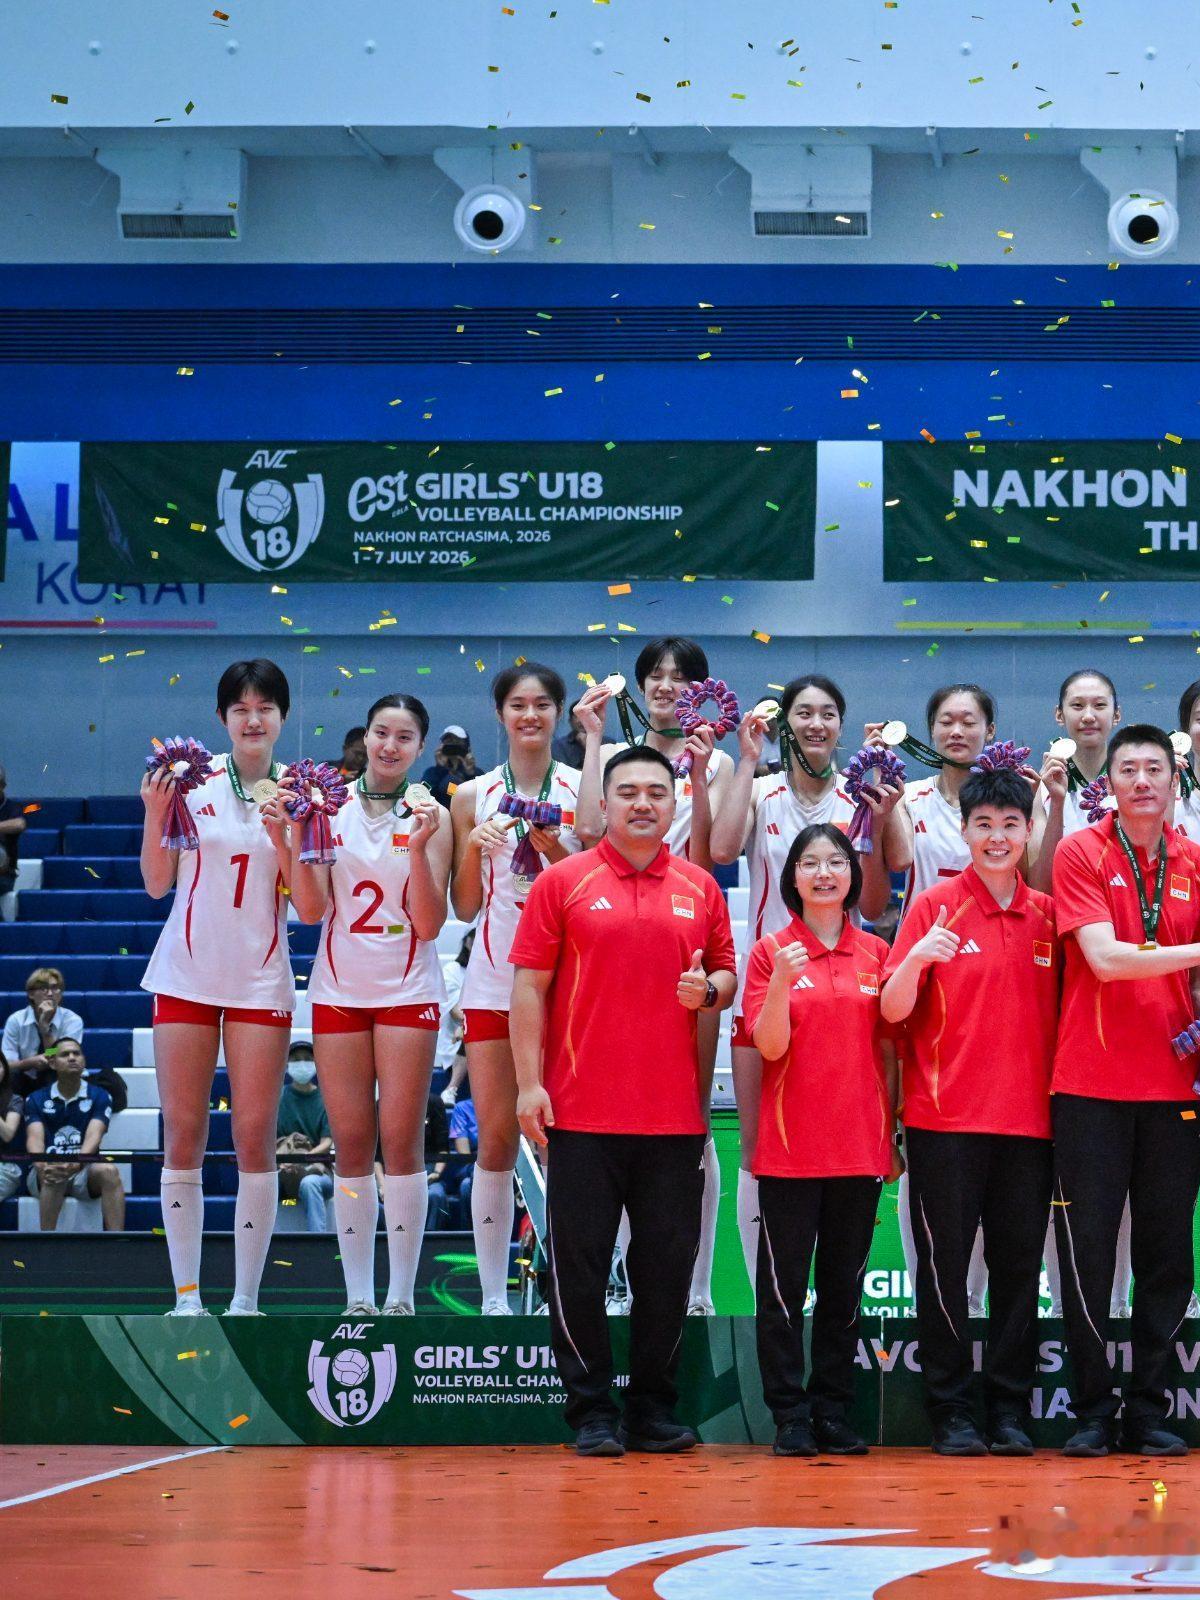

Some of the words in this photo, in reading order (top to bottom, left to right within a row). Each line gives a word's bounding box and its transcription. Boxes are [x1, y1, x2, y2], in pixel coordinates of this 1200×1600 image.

[244, 450, 298, 469] AVC
[348, 470, 408, 522] est
[415, 471, 528, 500] GIRLS'
[538, 471, 603, 499] U18
[953, 469, 1187, 507] NAKHON
[416, 506, 536, 522] VOLLEYBALL
[540, 505, 683, 521] CHAMPIONSHIP
[250, 526, 291, 561] 18
[353, 531, 416, 543] NAKHON
[419, 531, 513, 544] RATCHASIMA,
[516, 531, 551, 542] 2026
[387, 551, 425, 564] JULY
[430, 551, 469, 564] 2026
[230, 853, 250, 909] 1
[349, 880, 385, 934] 2
[675, 908, 692, 917] CHN
[331, 1323, 375, 1339] AVC
[414, 1346, 508, 1369] GIRLS'
[516, 1346, 557, 1369] U1
[414, 1375, 513, 1388] VOLLEYBALL
[335, 1388, 369, 1418] 18
[413, 1394, 464, 1404] NAKHON
[467, 1394, 545, 1405] RATCHASIMA,
[547, 1394, 569, 1404] 202
